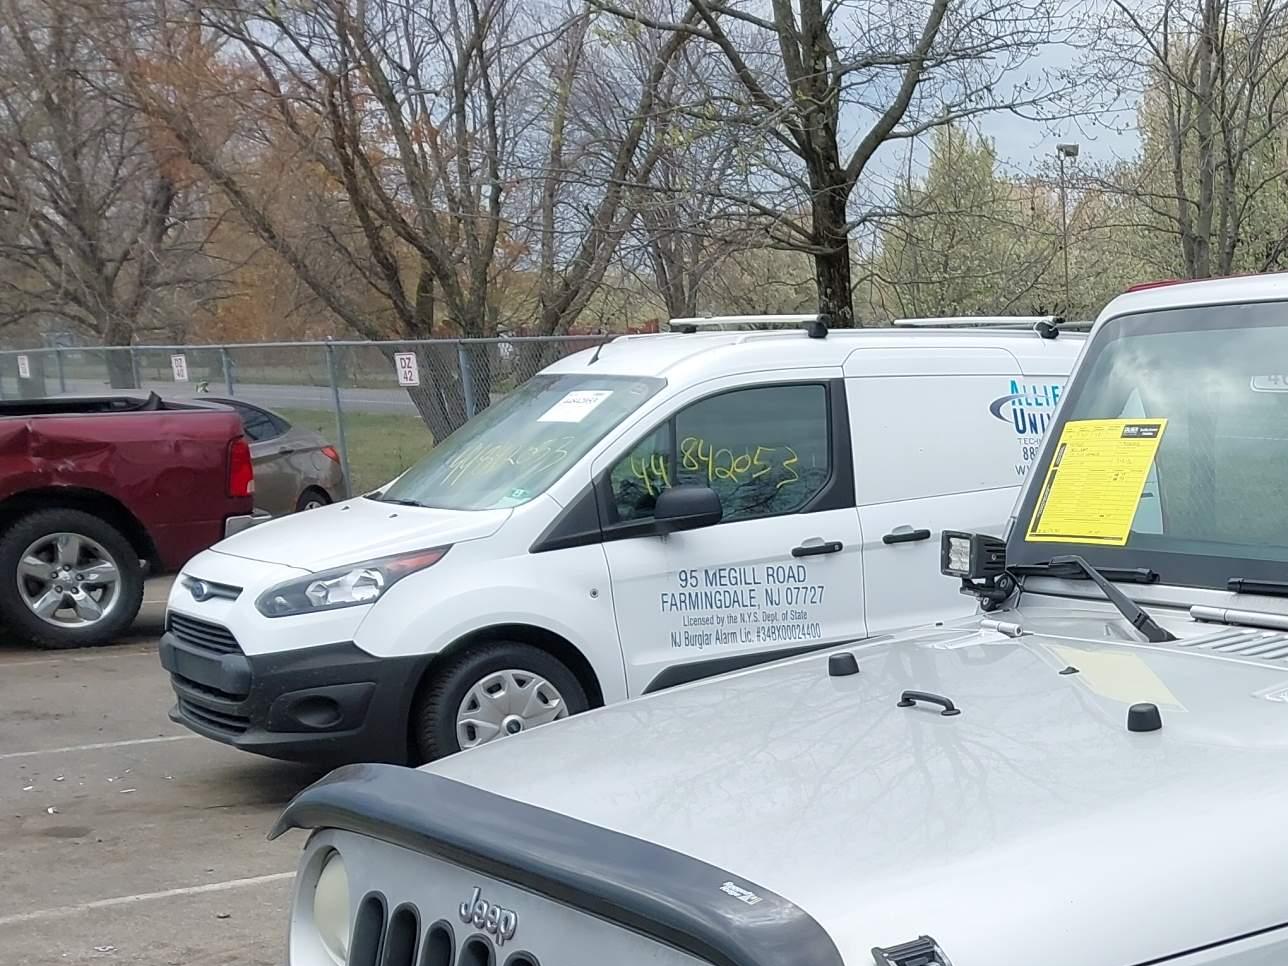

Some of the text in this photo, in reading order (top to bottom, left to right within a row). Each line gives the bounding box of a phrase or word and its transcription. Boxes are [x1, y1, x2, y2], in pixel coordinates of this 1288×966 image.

[399, 357, 413, 369] DZ
[402, 369, 414, 382] 42
[1010, 379, 1065, 407] ALLIE
[678, 565, 807, 588] 95 MEGILL ROAD
[661, 586, 825, 612] FARMINGDALE, NJ 07727
[682, 614, 714, 627] Licensed
[716, 613, 726, 626] by
[727, 613, 738, 624] the
[740, 612, 760, 624] N.Y.S.
[781, 610, 789, 621] of
[790, 609, 808, 621] State
[670, 632, 682, 648] NJ
[684, 630, 713, 650] Burglar
[715, 629, 737, 645] Alarm
[739, 628, 754, 644] Lic.
[459, 886, 518, 947] Jeep
